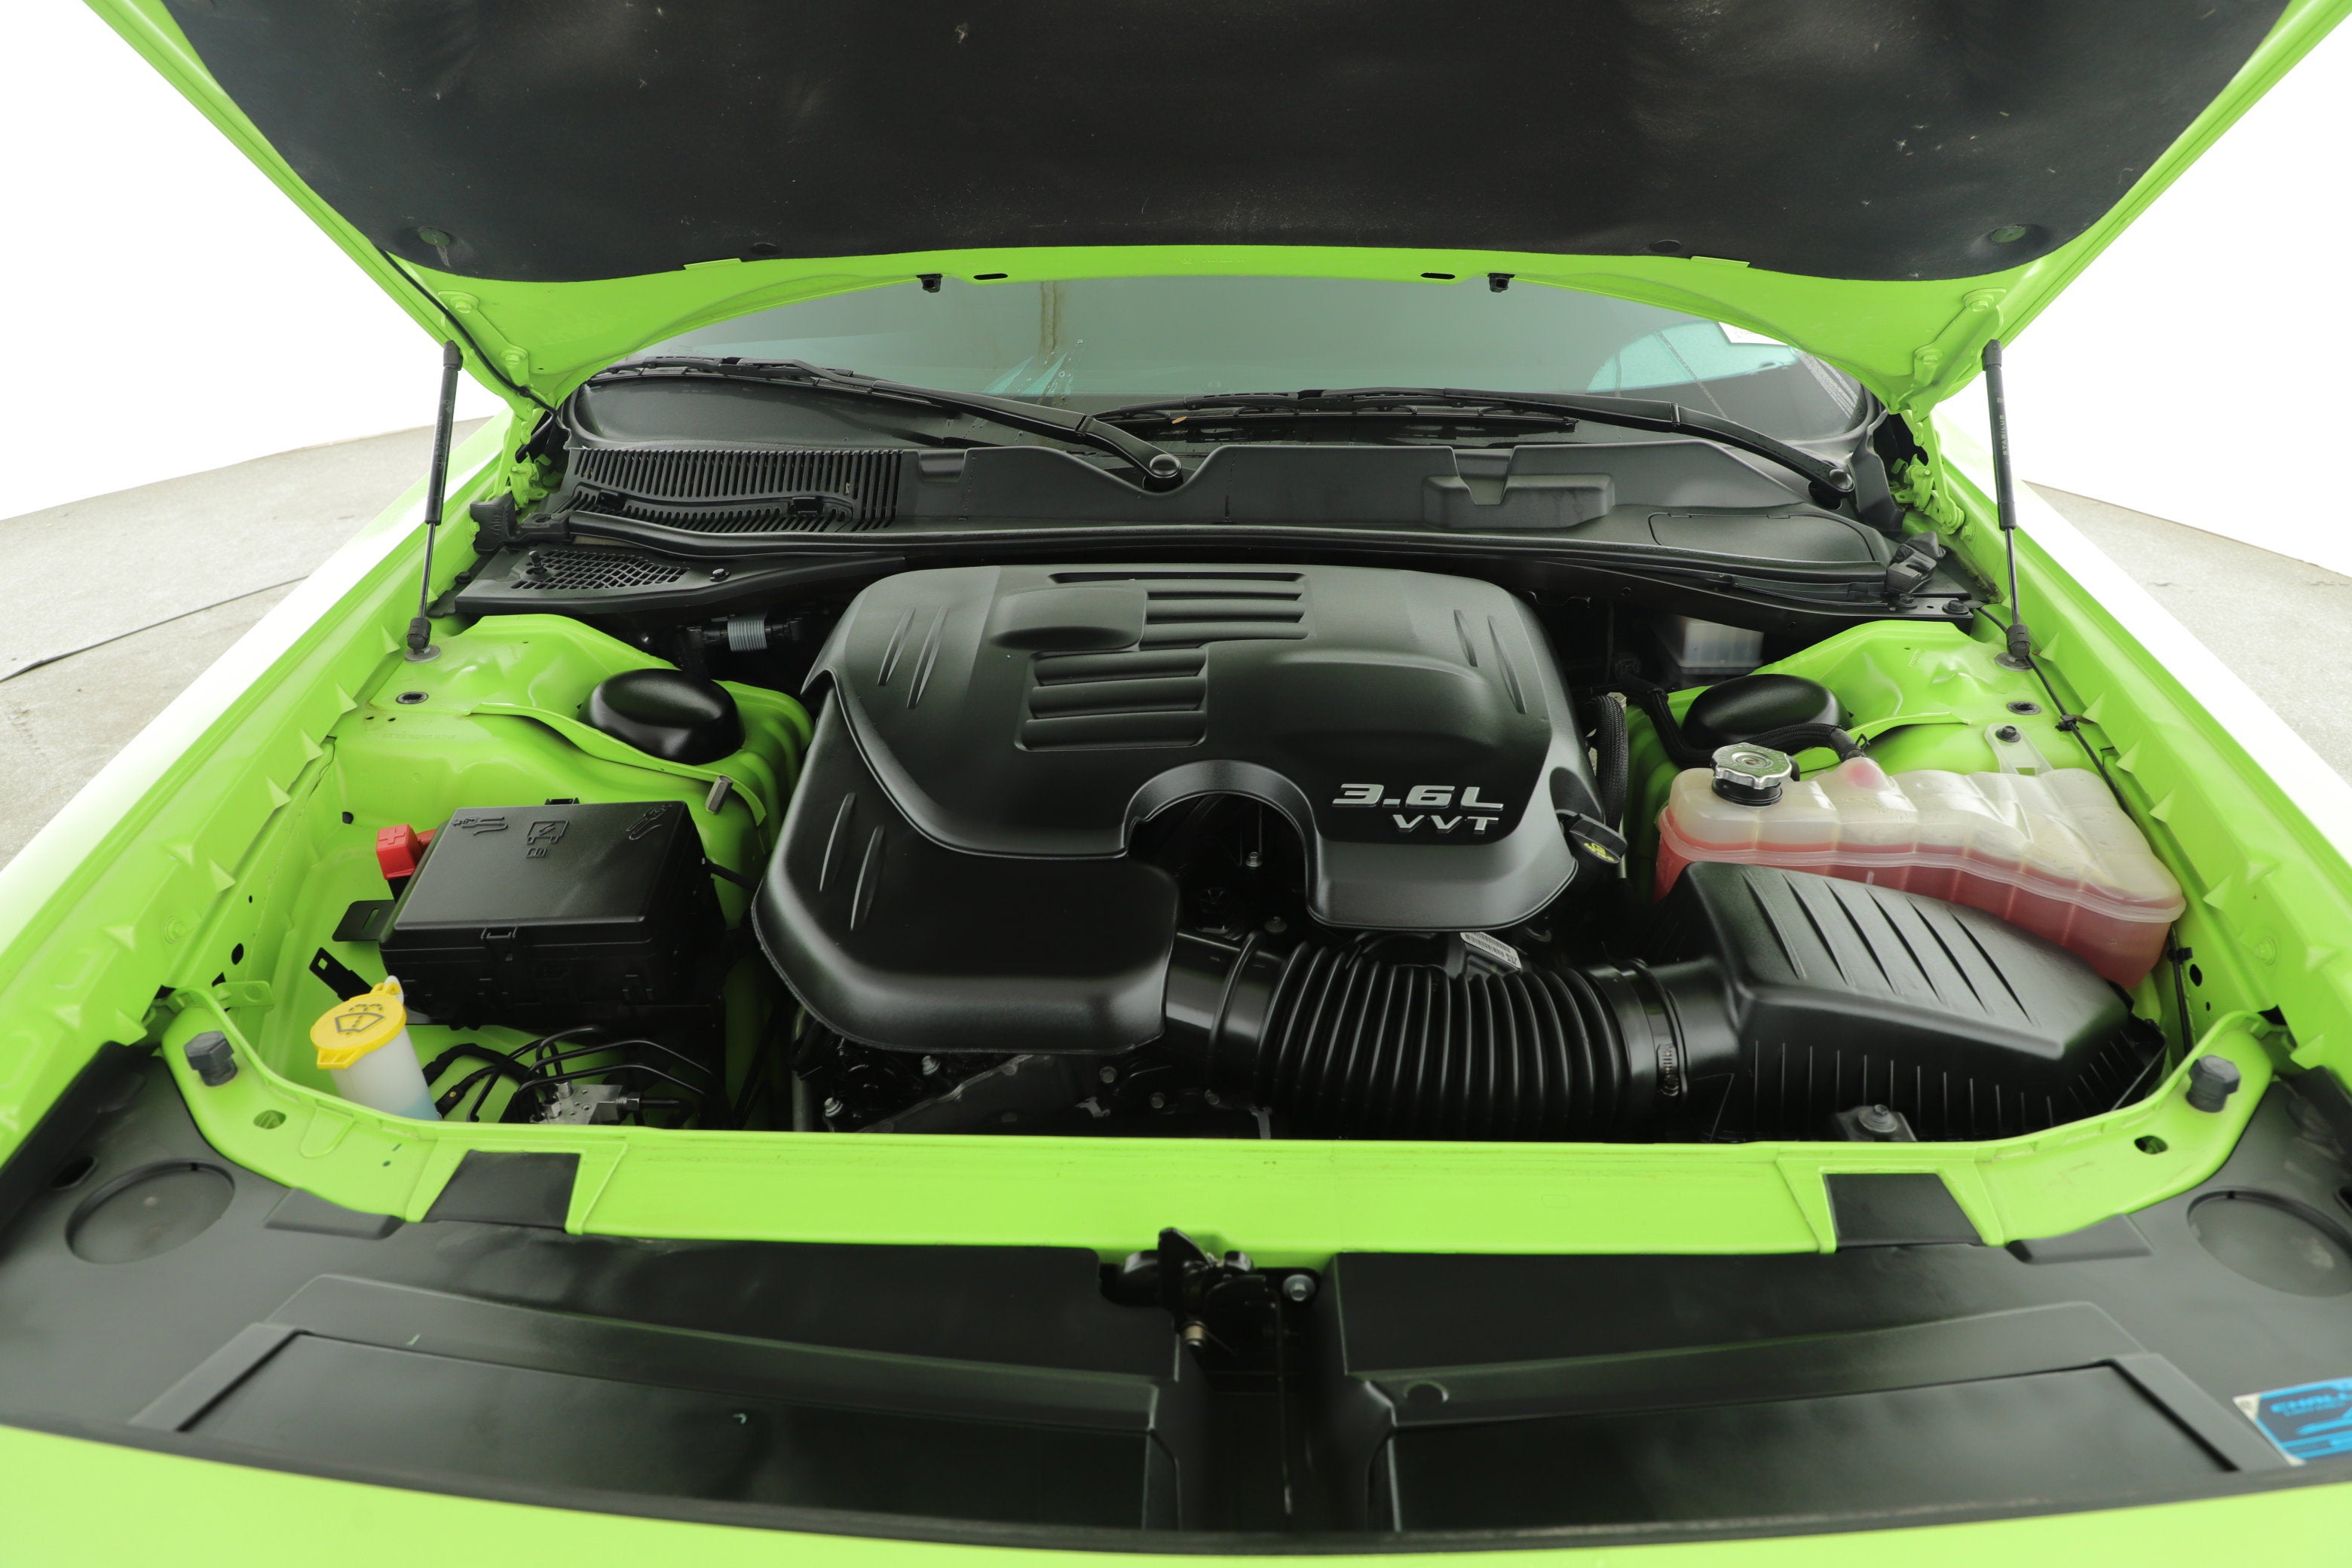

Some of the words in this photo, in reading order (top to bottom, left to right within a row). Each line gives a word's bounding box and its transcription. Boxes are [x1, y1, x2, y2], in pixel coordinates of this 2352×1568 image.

[1999, 415, 2009, 455] STABILUS
[1332, 783, 1504, 811] 3.6L
[1392, 814, 1499, 835] VVT
